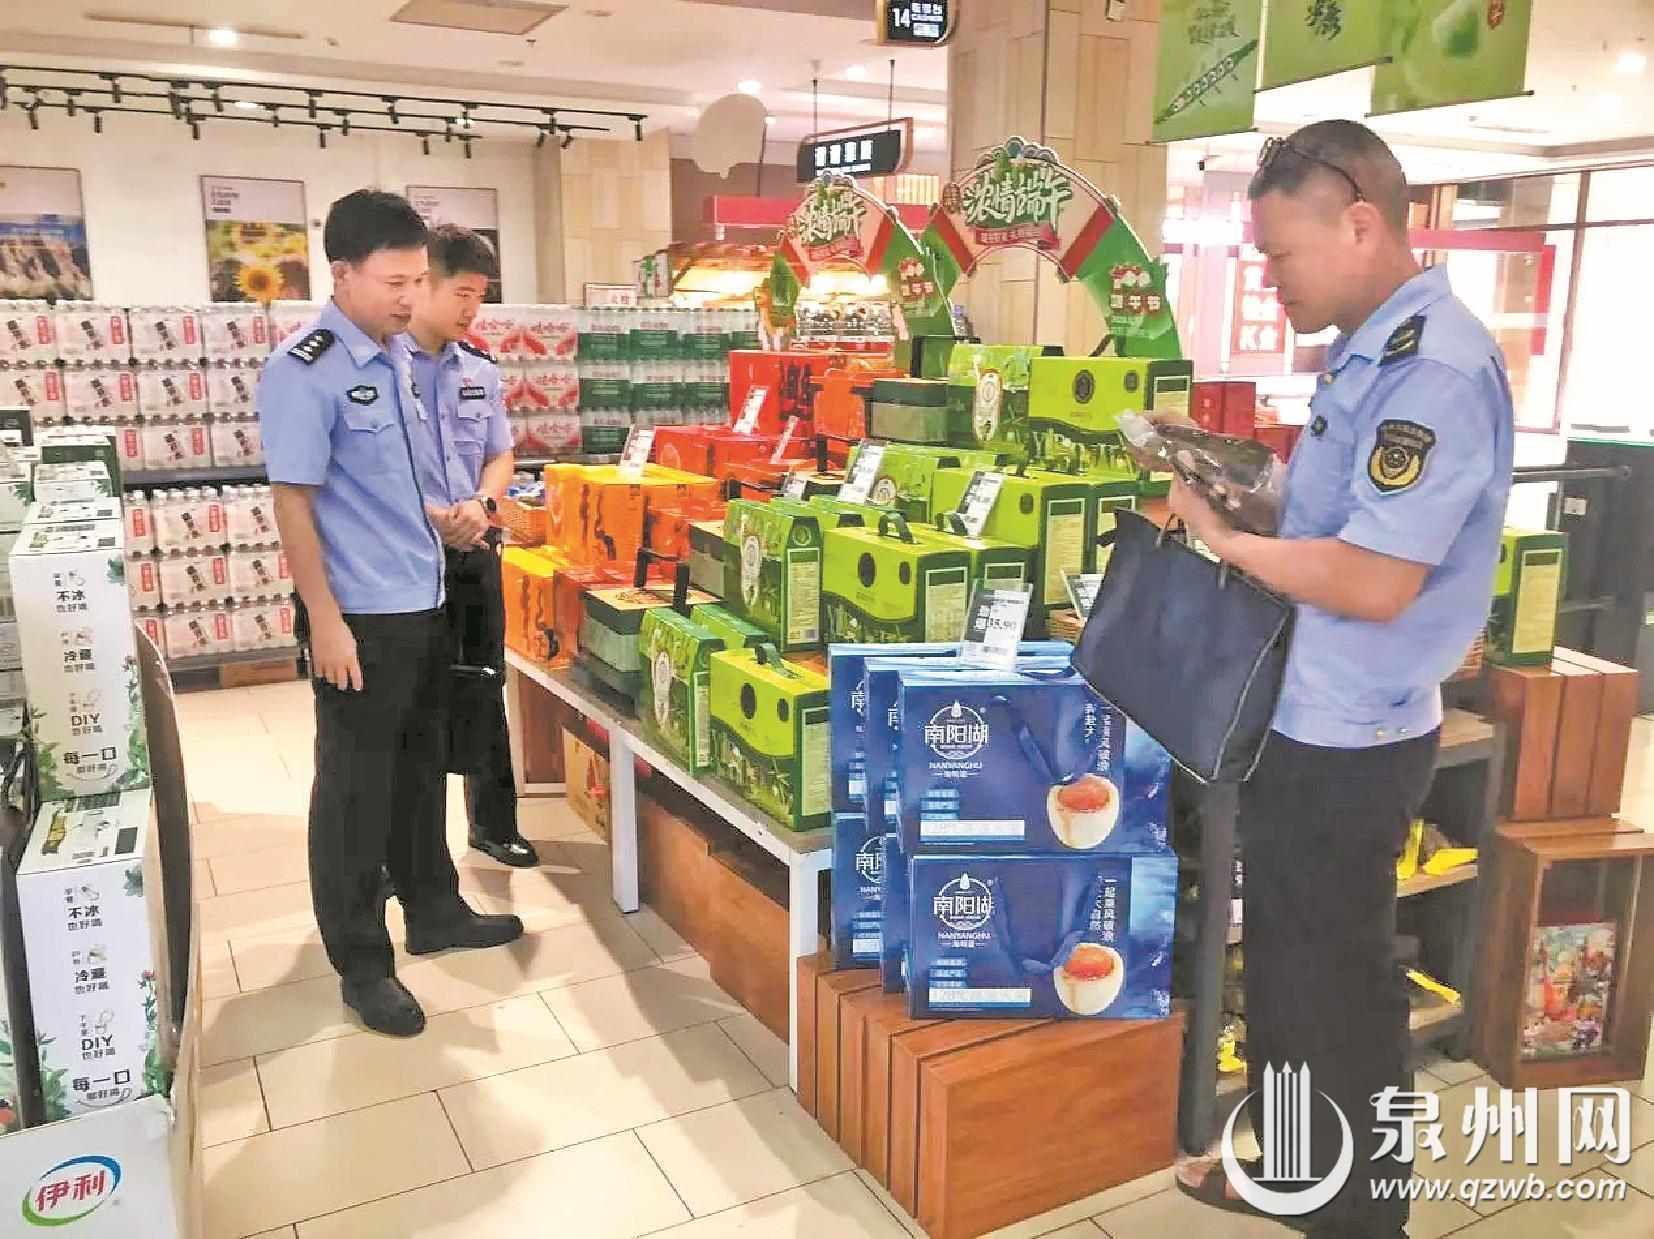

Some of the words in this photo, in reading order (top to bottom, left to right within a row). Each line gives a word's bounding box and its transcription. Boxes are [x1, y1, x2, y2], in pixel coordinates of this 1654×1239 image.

[892, 8, 911, 27] 14
[72, 713, 100, 727] DIY
[924, 724, 990, 744] 南阳湖
[64, 746, 117, 765] 每一口
[81, 1034, 113, 1051] DIY
[73, 1068, 131, 1092] 每一口
[37, 1169, 106, 1213] 伊利
